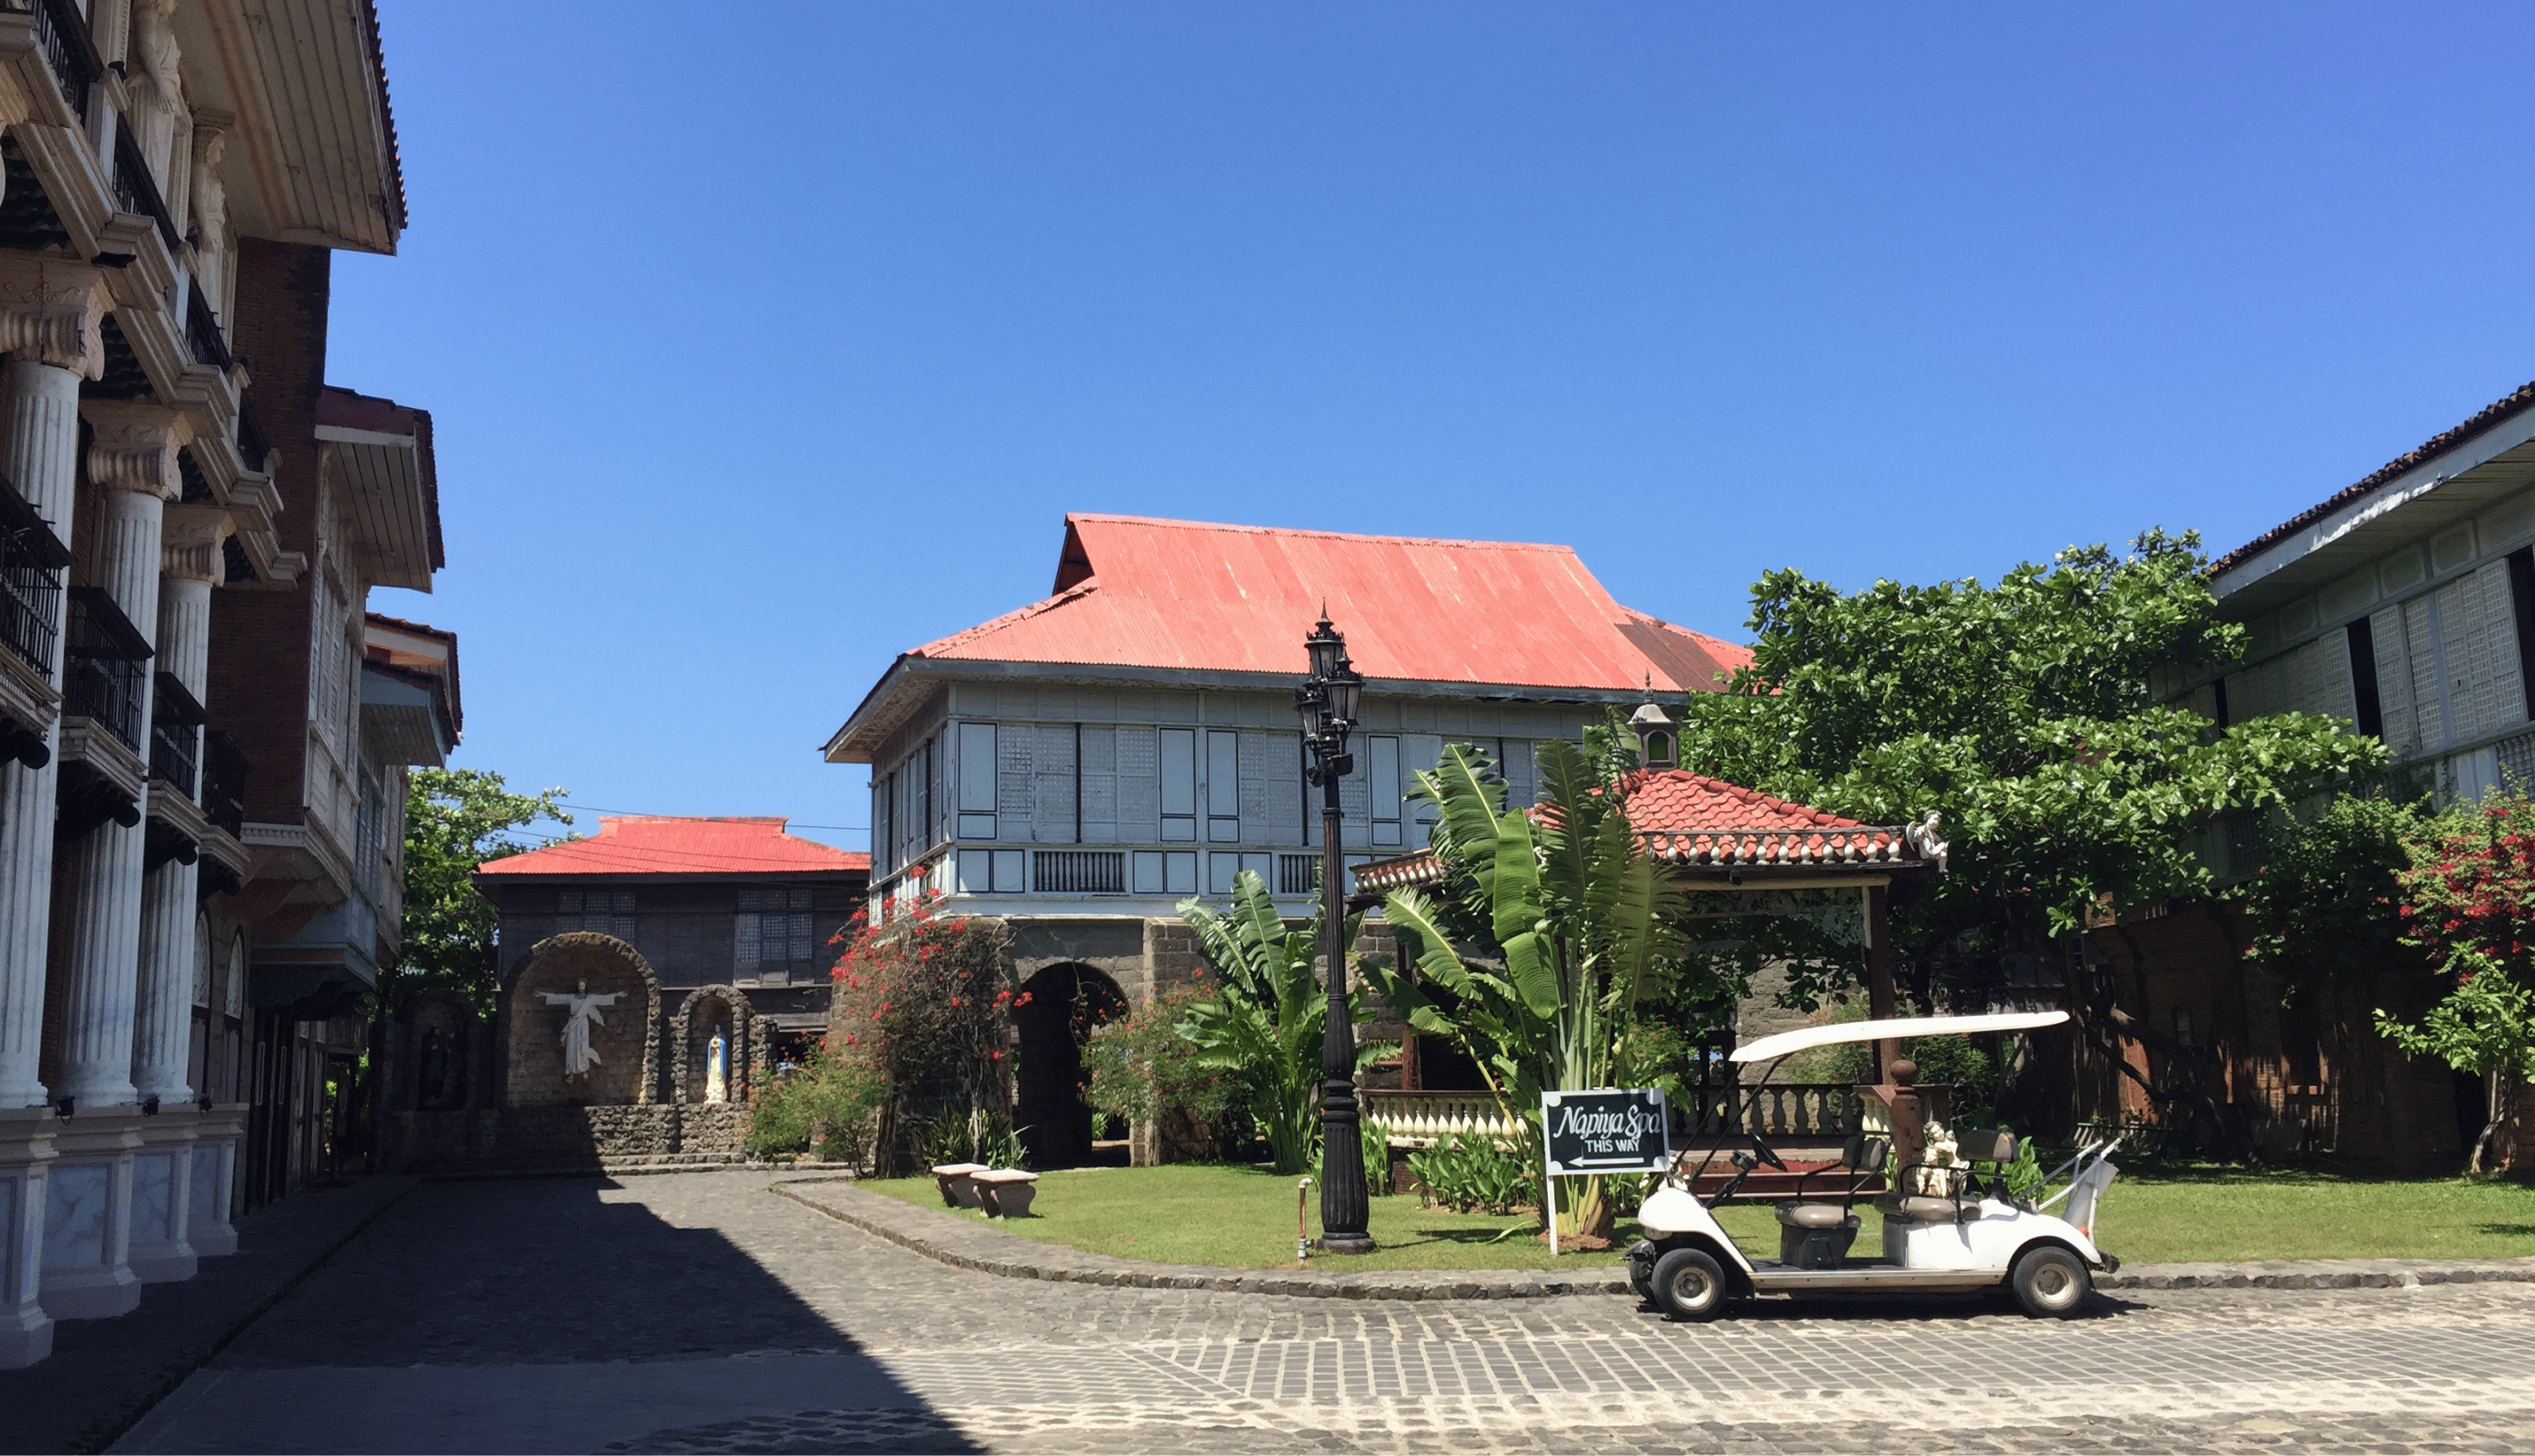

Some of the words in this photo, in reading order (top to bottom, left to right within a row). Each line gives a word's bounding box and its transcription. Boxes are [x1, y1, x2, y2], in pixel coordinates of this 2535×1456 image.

[1553, 1106, 1624, 1139] Napiya
[1625, 1104, 1661, 1139] Spa
[1584, 1139, 1613, 1152] THIS
[1615, 1139, 1640, 1152] WAY
